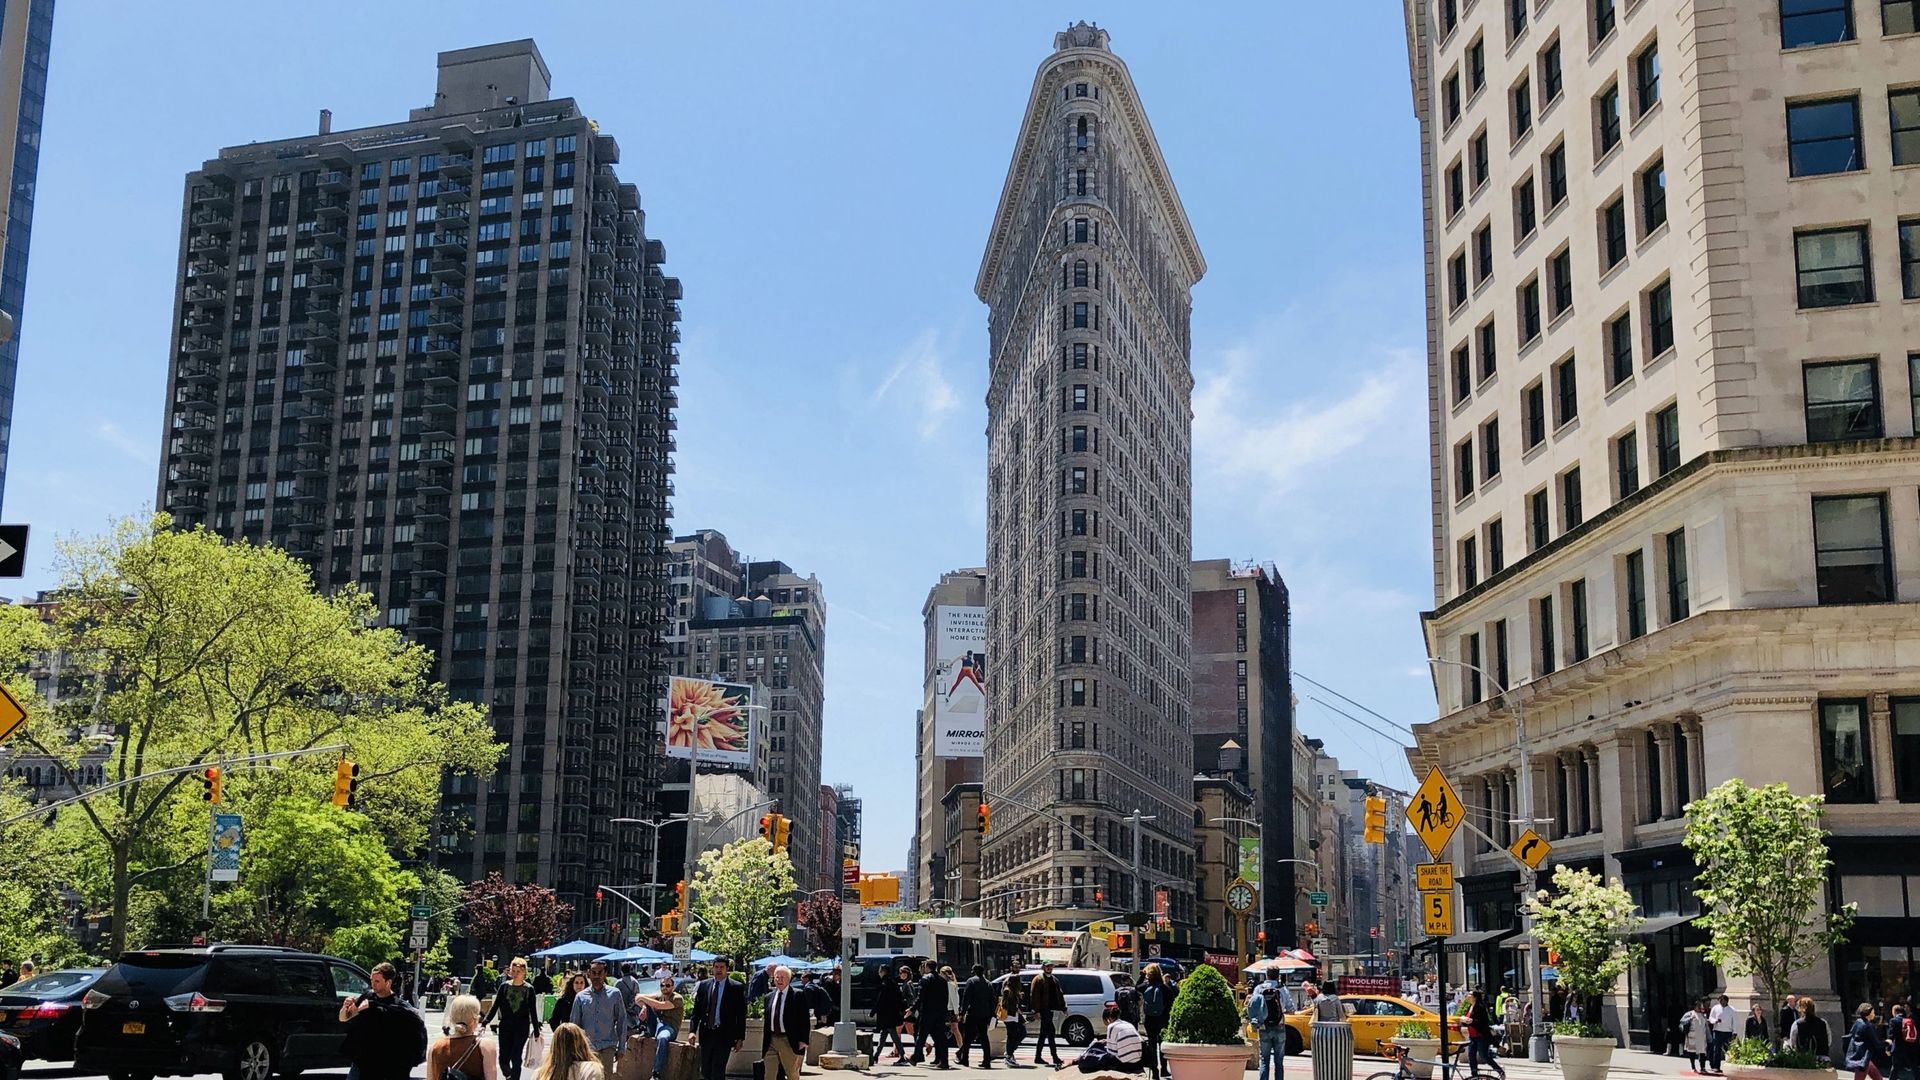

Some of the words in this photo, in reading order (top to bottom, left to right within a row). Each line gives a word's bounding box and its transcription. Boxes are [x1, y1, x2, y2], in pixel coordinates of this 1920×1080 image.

[946, 730, 984, 738] MIRROR
[1421, 867, 1438, 876] SHARE
[1439, 866, 1449, 875] THE
[1428, 877, 1443, 886] ROAD
[1433, 898, 1443, 918] 5
